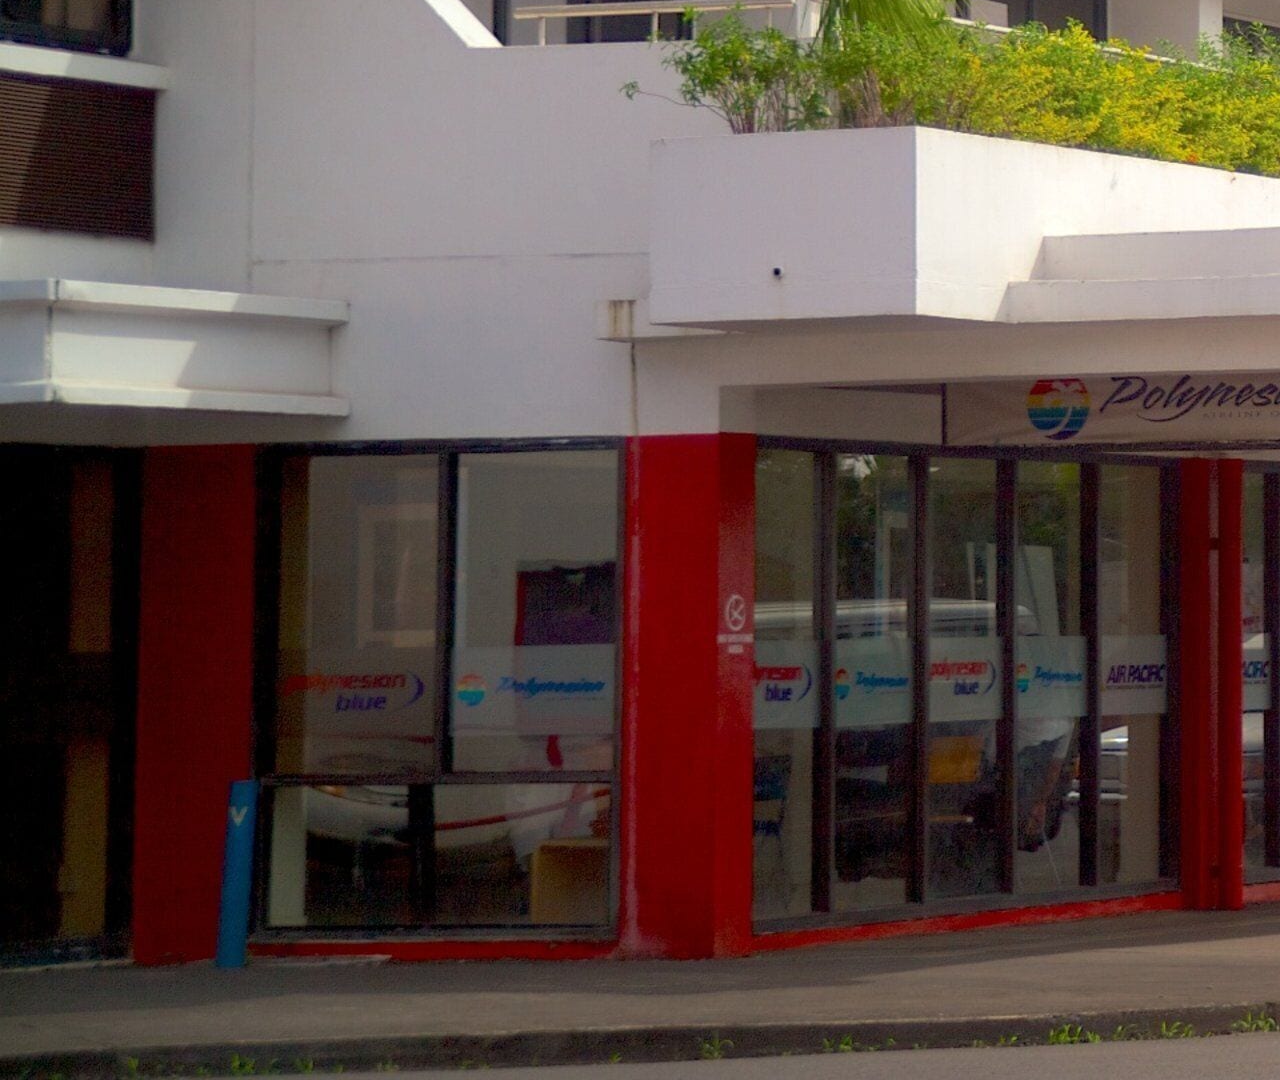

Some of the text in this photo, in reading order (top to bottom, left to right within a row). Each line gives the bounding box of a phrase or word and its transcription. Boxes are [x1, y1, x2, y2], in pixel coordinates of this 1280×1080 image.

[1107, 664, 1167, 683] AIR PACIFIC
[765, 684, 793, 701] blue
[954, 680, 980, 696] blue
[335, 694, 387, 713] blue
